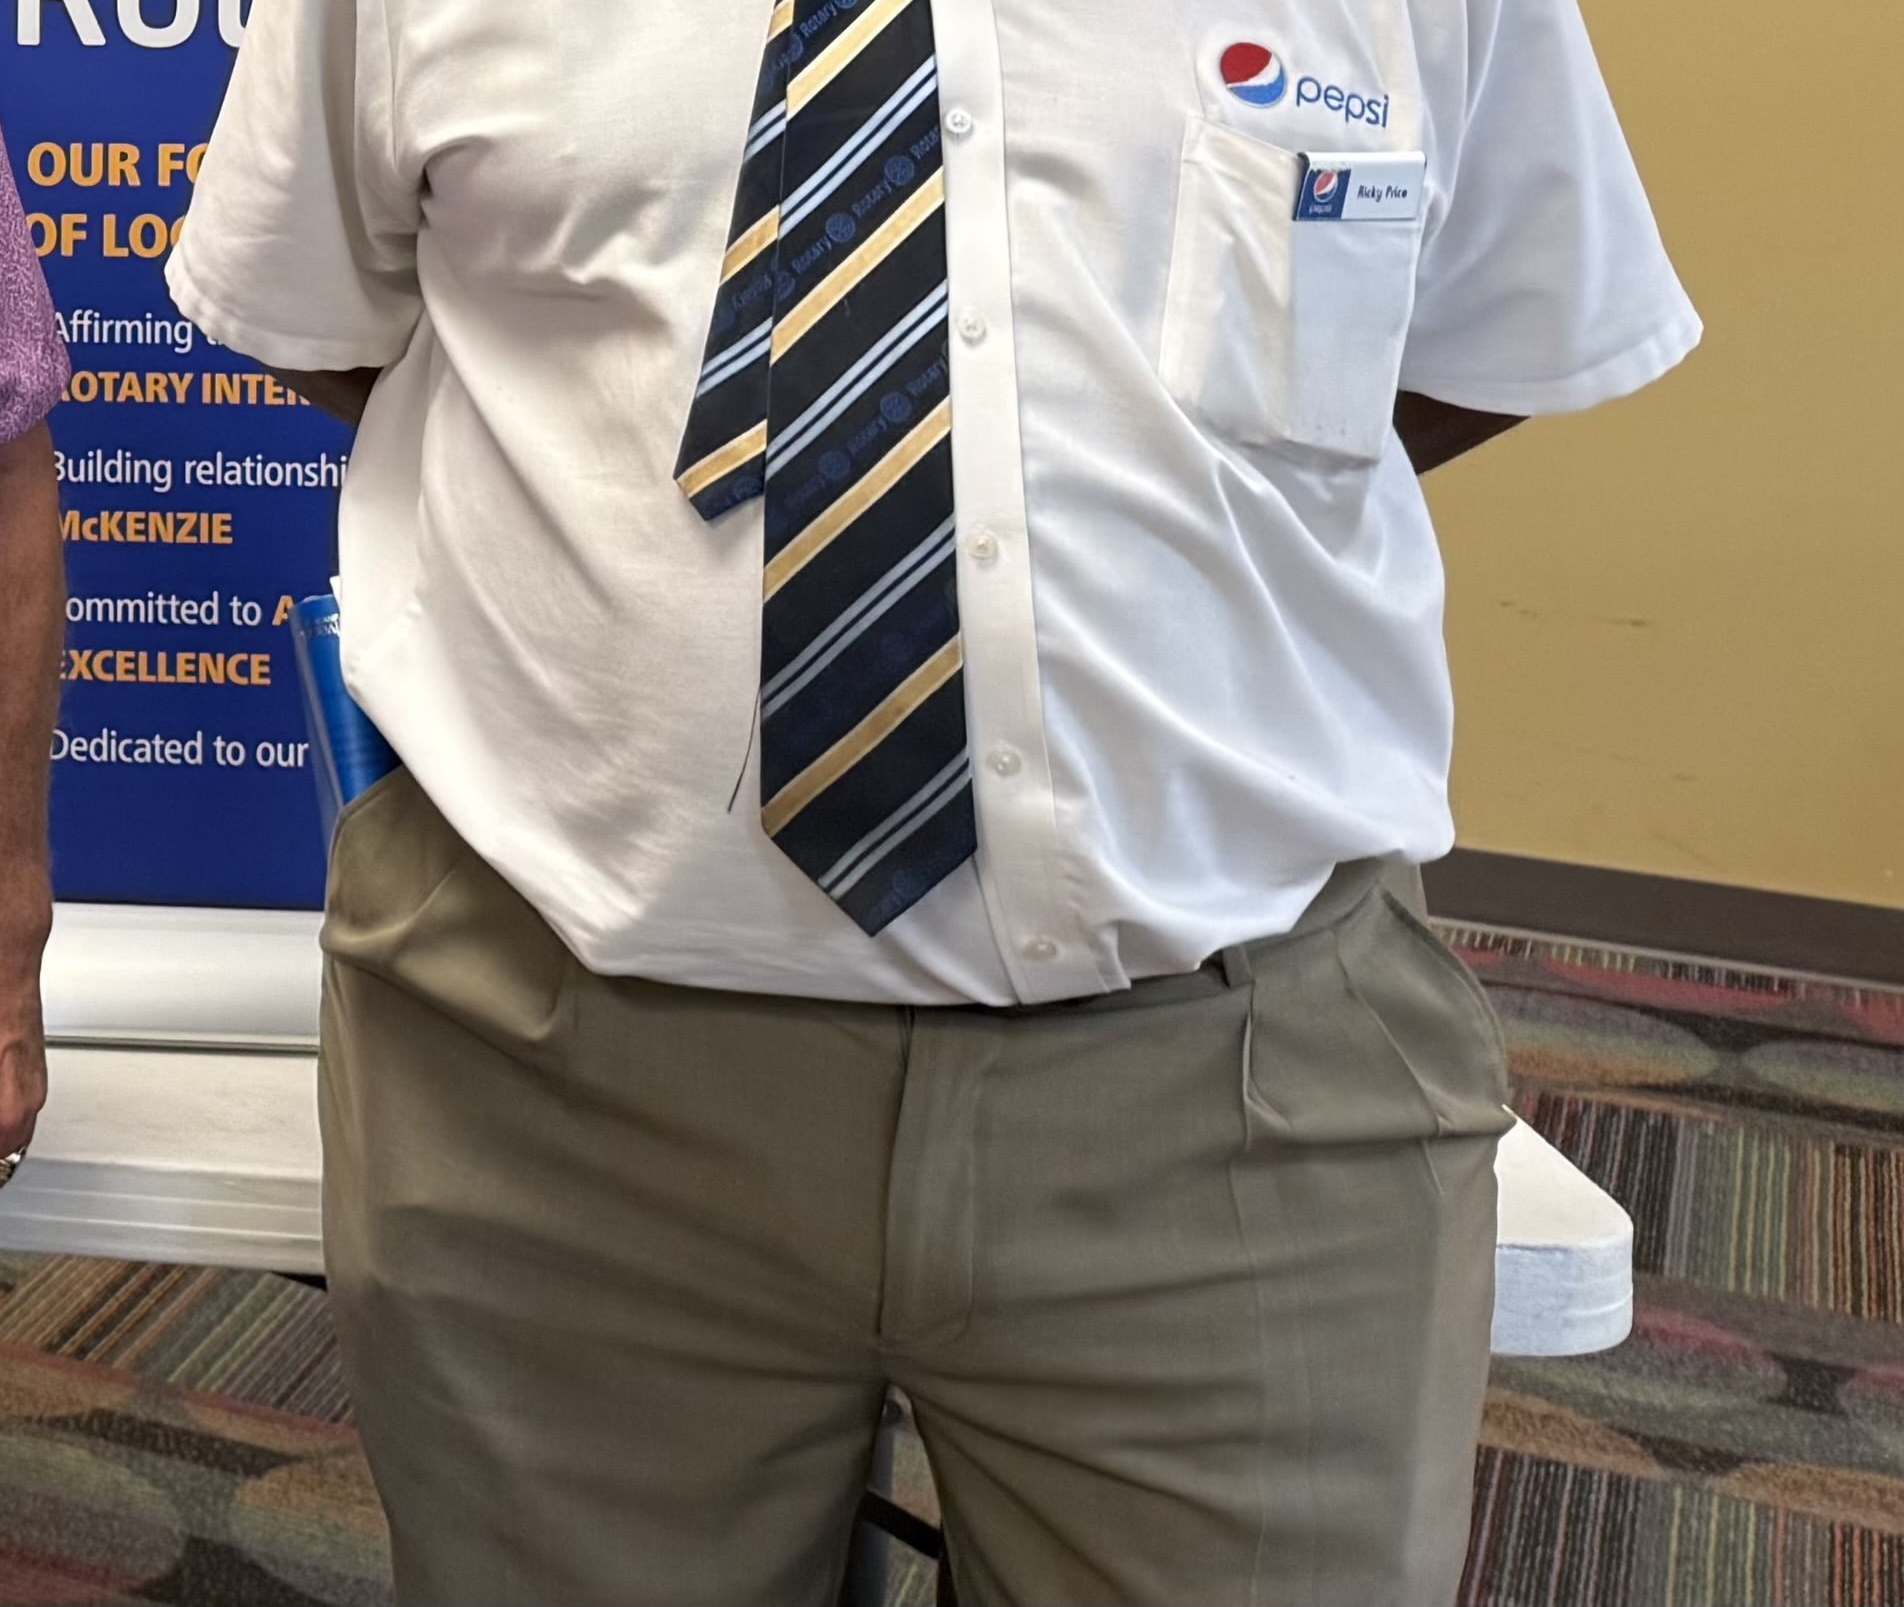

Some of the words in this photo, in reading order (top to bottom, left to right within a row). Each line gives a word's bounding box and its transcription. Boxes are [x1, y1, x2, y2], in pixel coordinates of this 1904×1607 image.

[798, 2, 838, 39] Rotary
[1295, 76, 1390, 128] pepsi
[27, 141, 142, 187] OUR
[1357, 184, 1383, 203] Ricky
[1385, 184, 1408, 199] Price
[25, 212, 88, 258] OF
[54, 309, 193, 354] Affirming
[61, 370, 195, 404] OTARY
[53, 448, 173, 493] Building
[59, 509, 234, 545] McKENZIE
[65, 590, 220, 625] ommitted
[228, 595, 262, 627] to
[59, 649, 272, 686] XCELLENCE
[49, 727, 203, 766] Dedicated
[212, 735, 246, 767] to
[255, 741, 310, 768] our
